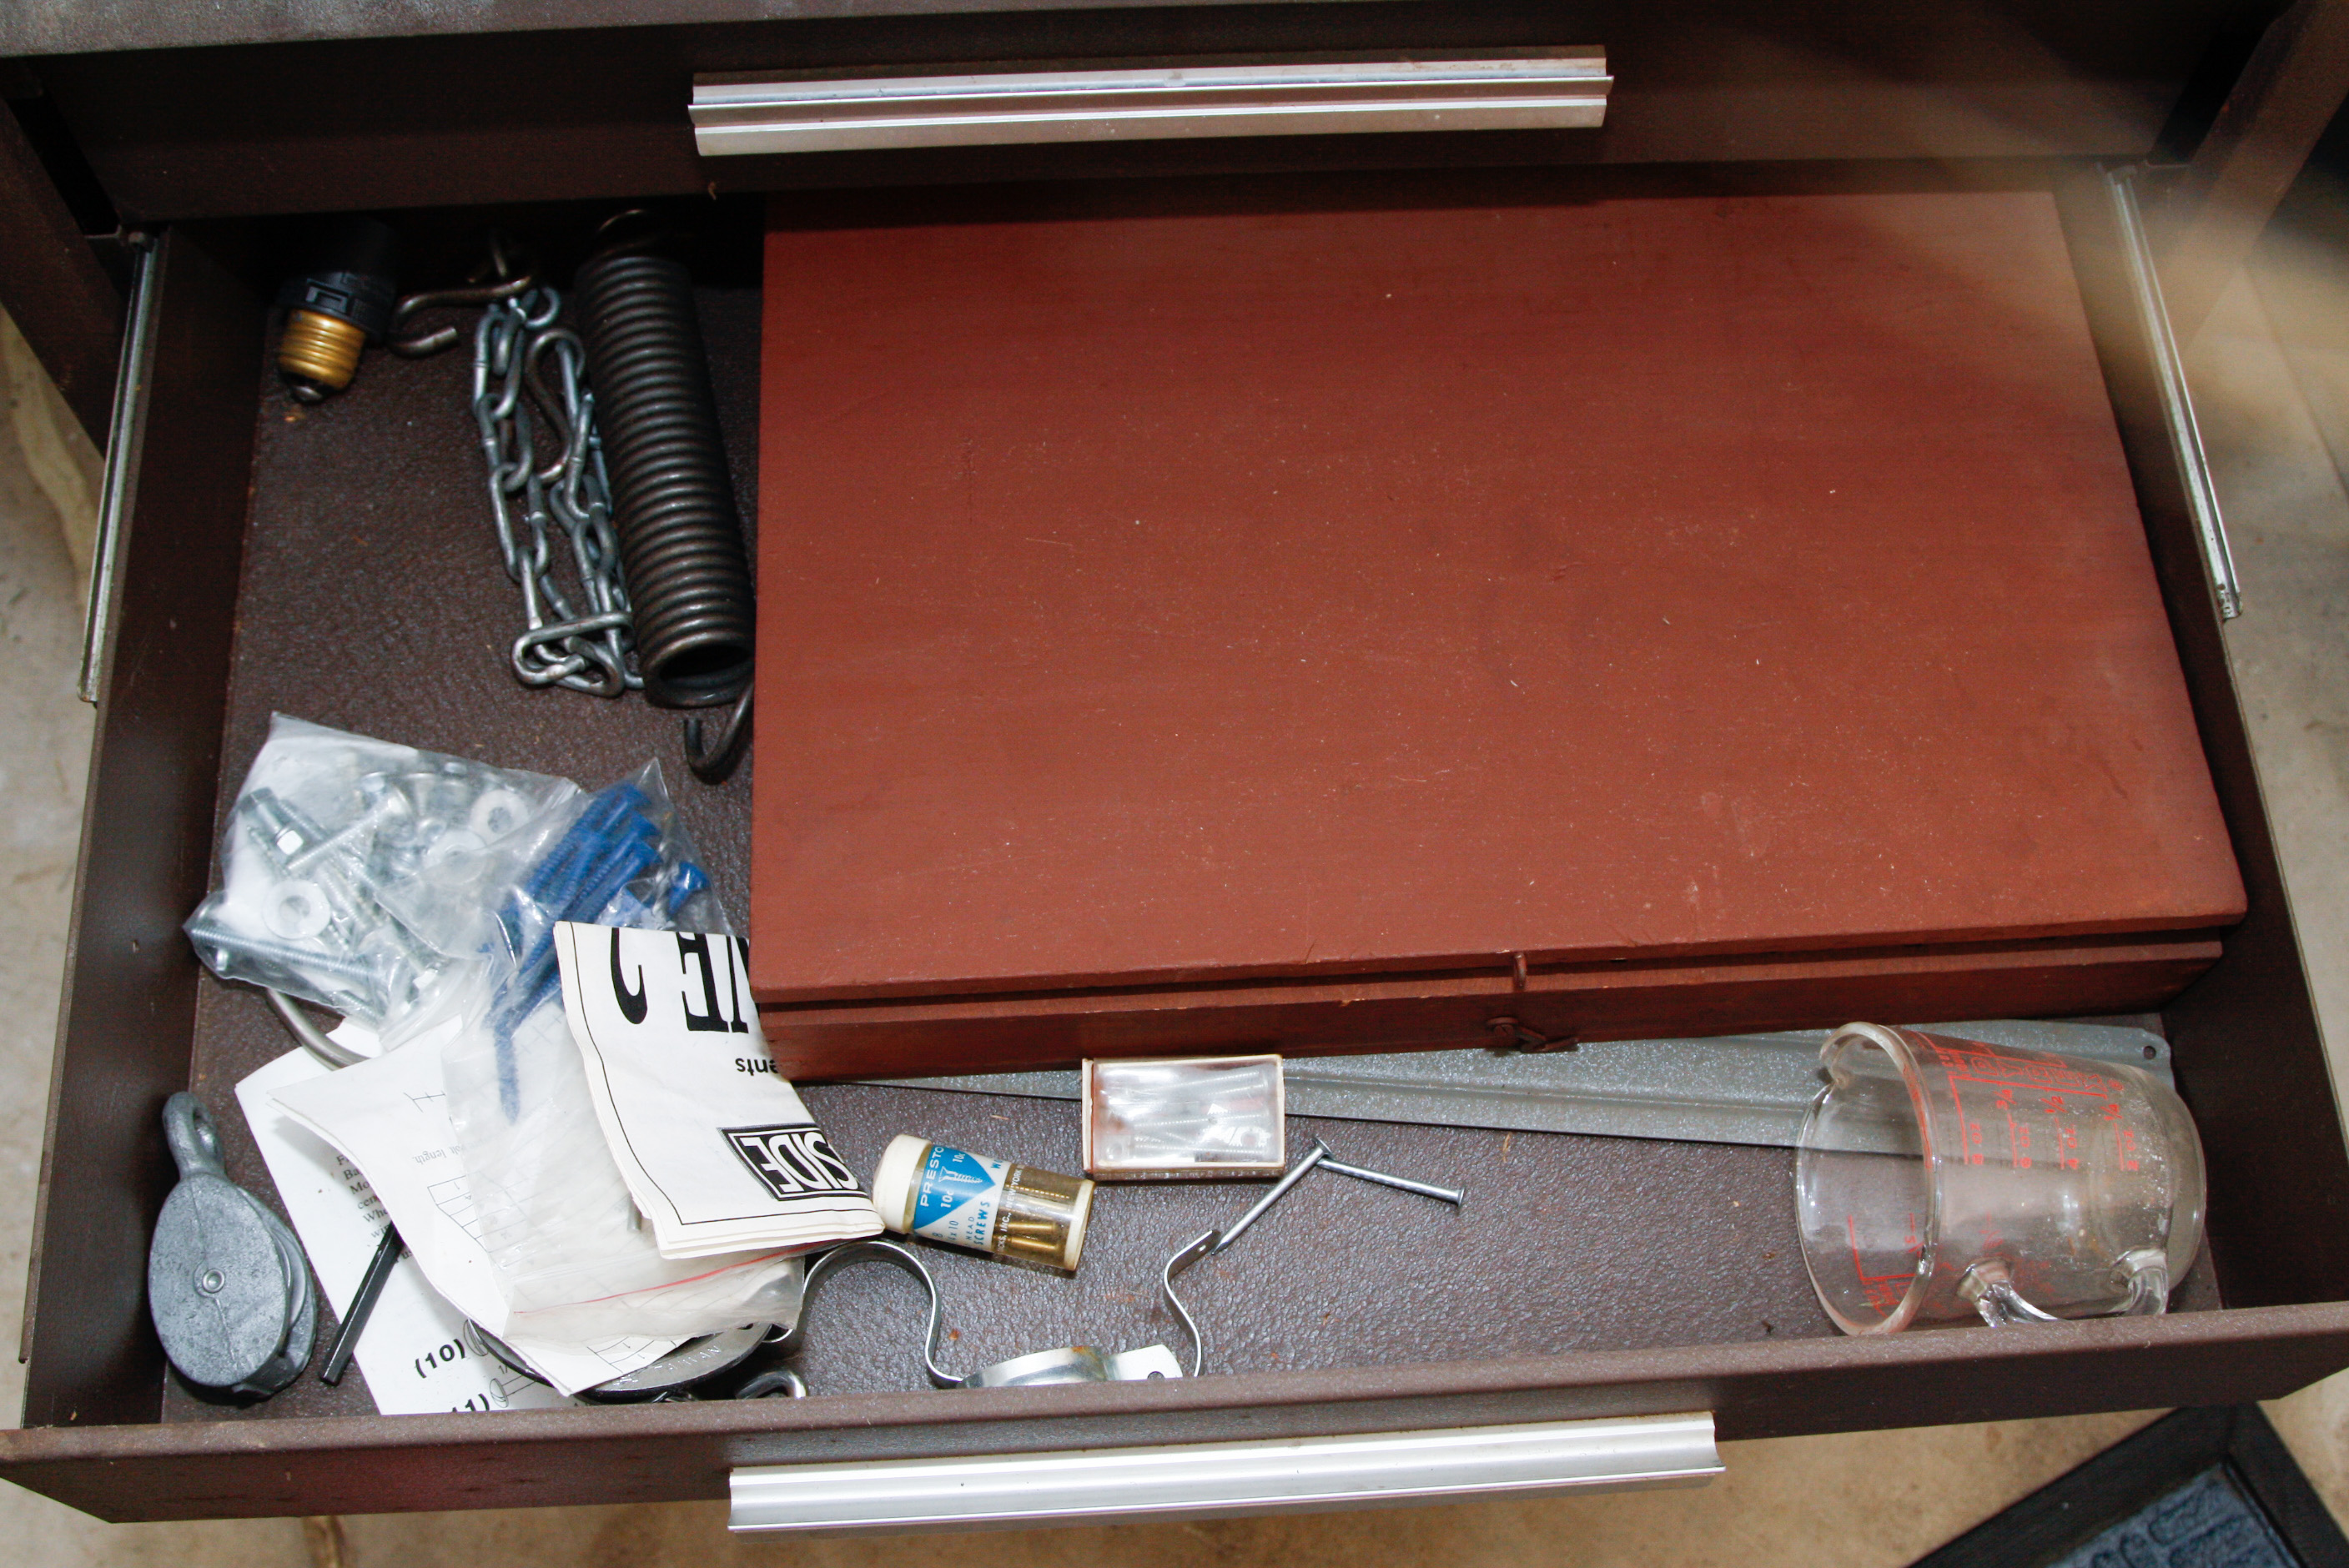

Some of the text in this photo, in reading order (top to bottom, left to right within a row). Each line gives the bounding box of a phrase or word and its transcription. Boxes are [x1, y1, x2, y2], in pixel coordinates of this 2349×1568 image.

[1969, 1055, 2107, 1091] PYREX
[740, 1131, 859, 1193] SIDE
[919, 1145, 944, 1207] PRESTO
[1005, 1189, 1015, 1209] NEW
[1010, 1168, 1023, 1187] YORK
[973, 1201, 990, 1245] SCREWS
[415, 1339, 465, 1377] (10)
